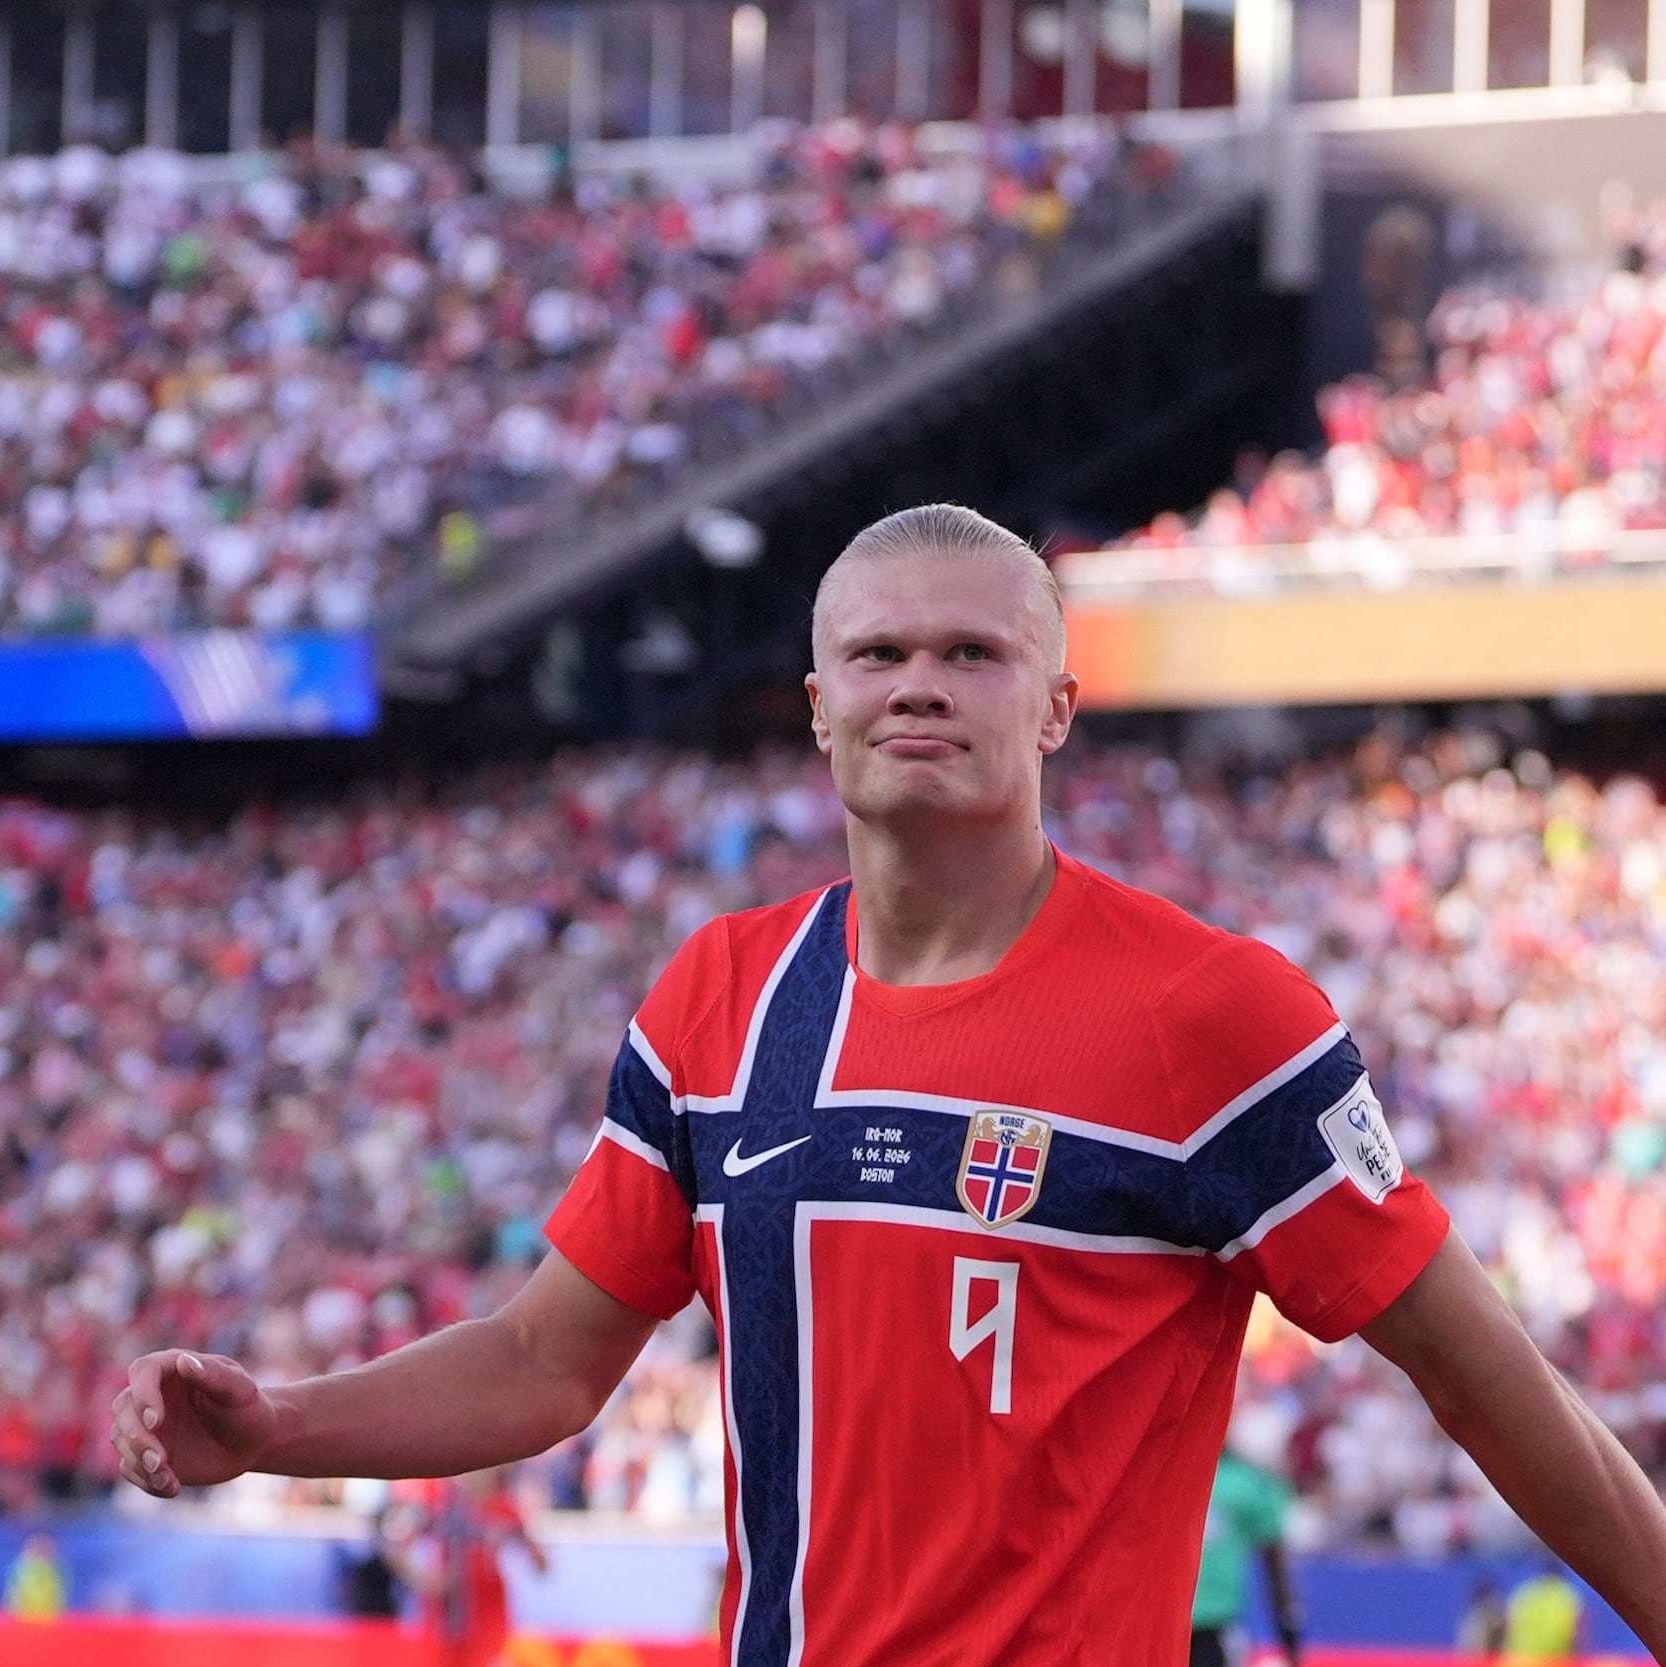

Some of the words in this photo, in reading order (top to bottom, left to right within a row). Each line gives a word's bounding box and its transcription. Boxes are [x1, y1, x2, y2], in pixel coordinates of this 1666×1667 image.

[999, 1115, 1026, 1129] NORGE
[860, 1167, 895, 1183] BOSTON
[948, 1255, 1021, 1415] 9
